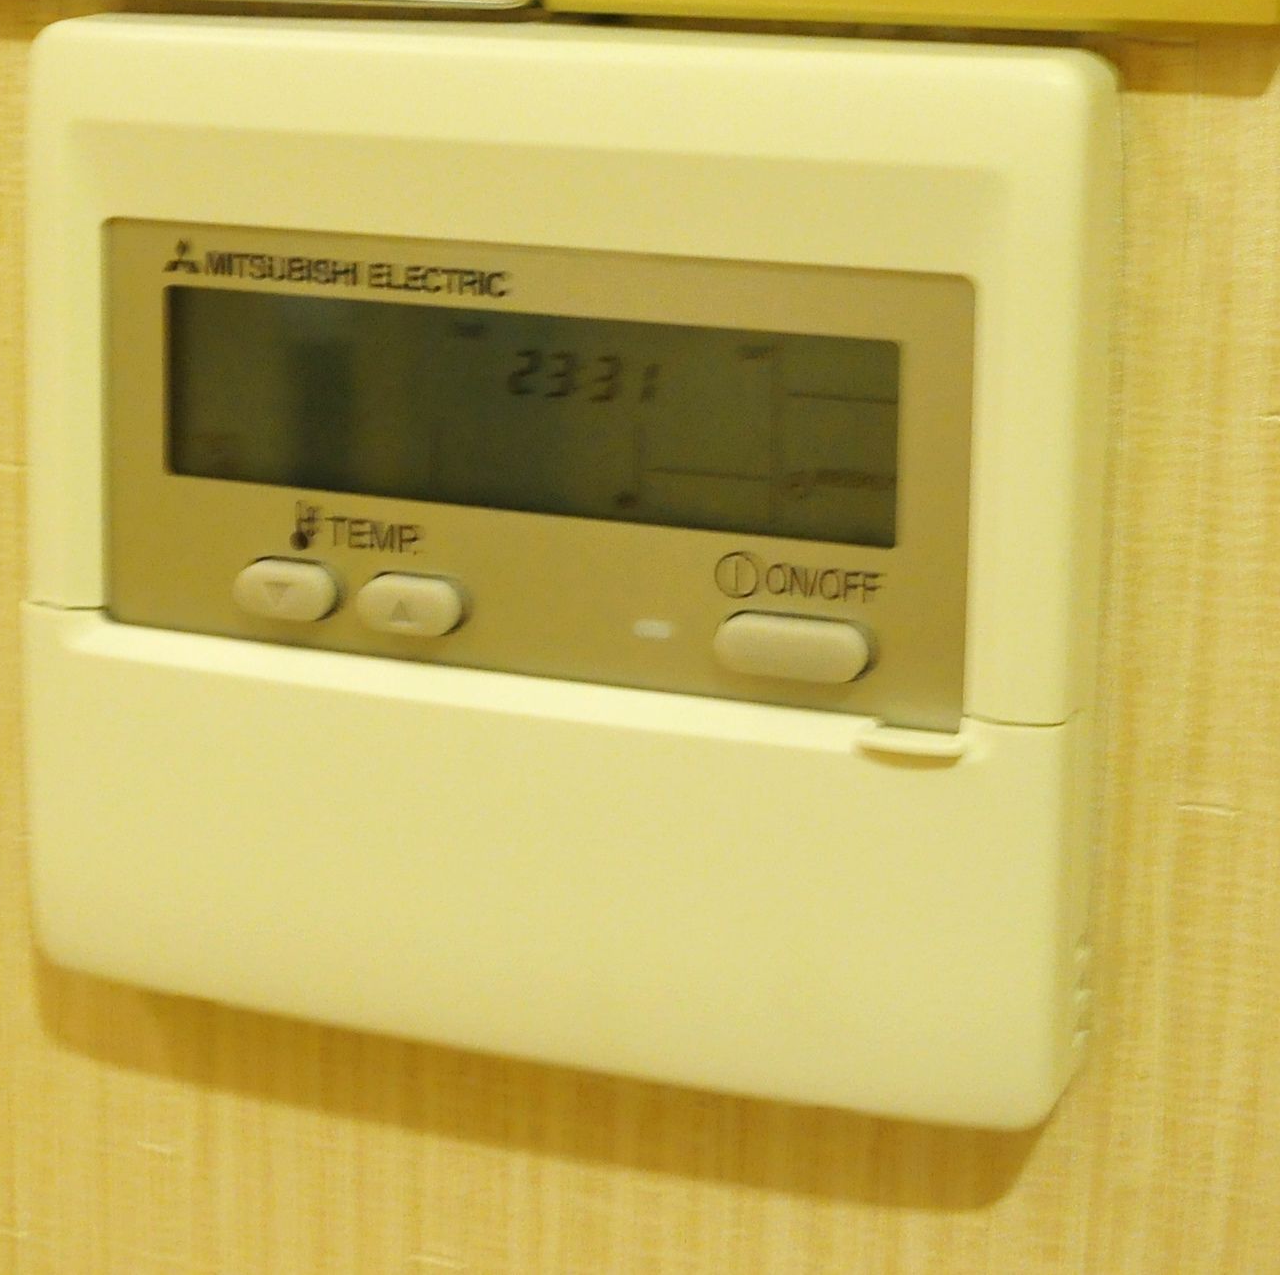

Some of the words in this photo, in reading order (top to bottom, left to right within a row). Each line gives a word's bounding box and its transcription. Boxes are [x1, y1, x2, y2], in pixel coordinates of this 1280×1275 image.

[205, 251, 358, 287] MITSUBISHI
[368, 262, 508, 298] ELECTRIC
[766, 562, 884, 603] ON/OFF
